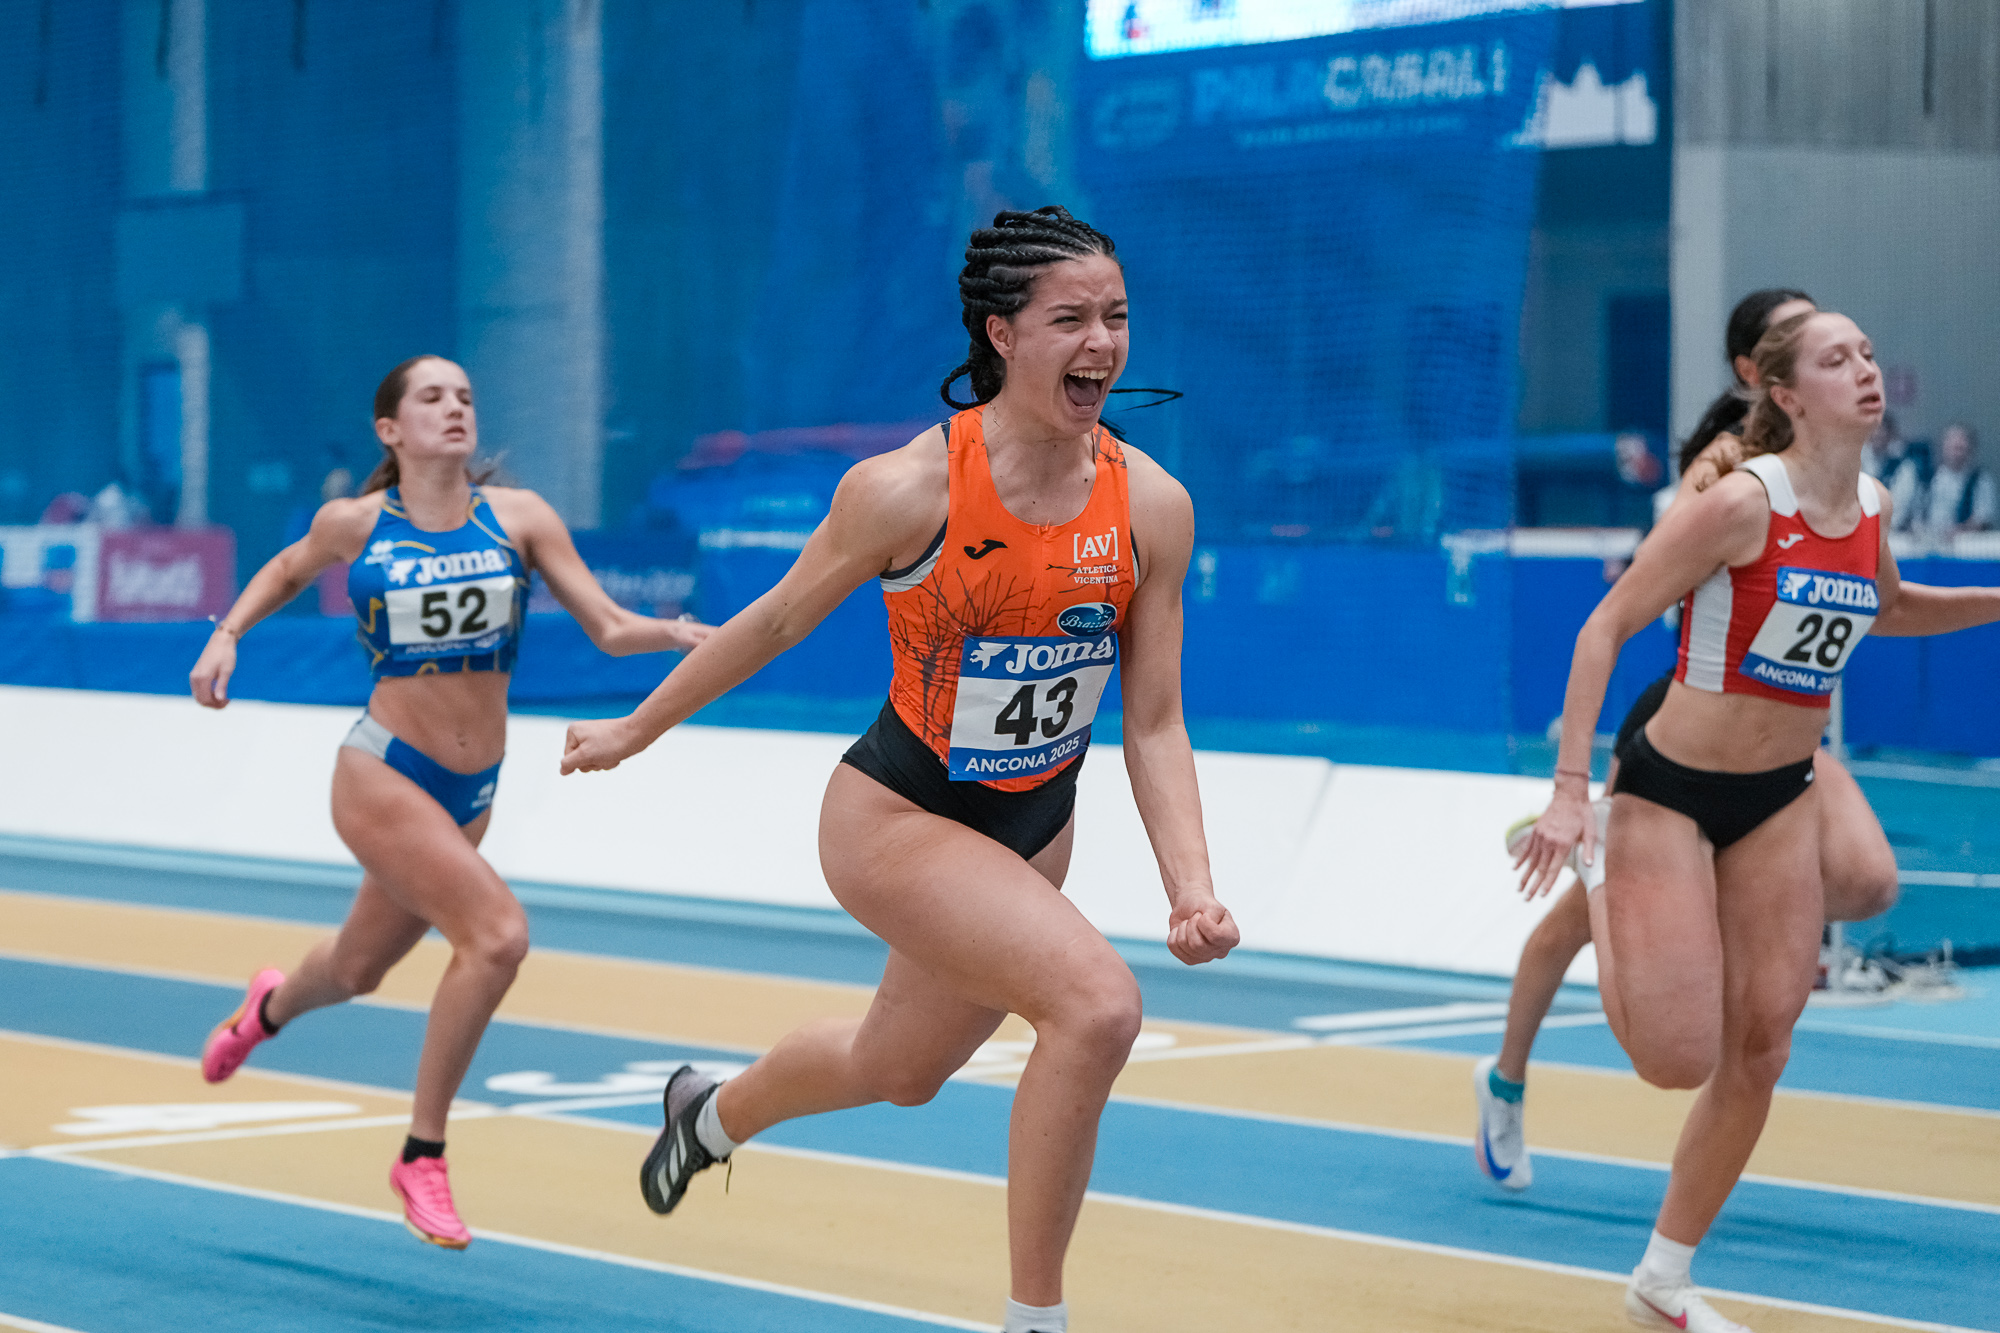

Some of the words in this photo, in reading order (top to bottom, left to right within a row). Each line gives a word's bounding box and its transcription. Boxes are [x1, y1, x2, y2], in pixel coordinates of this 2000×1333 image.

[1073, 574, 1119, 584] VICENTINA
[1076, 564, 1117, 574] ATLETICA
[421, 586, 488, 637] 52
[1783, 613, 1853, 668] 28
[1754, 662, 1816, 689] ANCONA
[994, 676, 1079, 746] 43
[965, 754, 1047, 773] ANCONA
[1049, 735, 1080, 763] 2025
